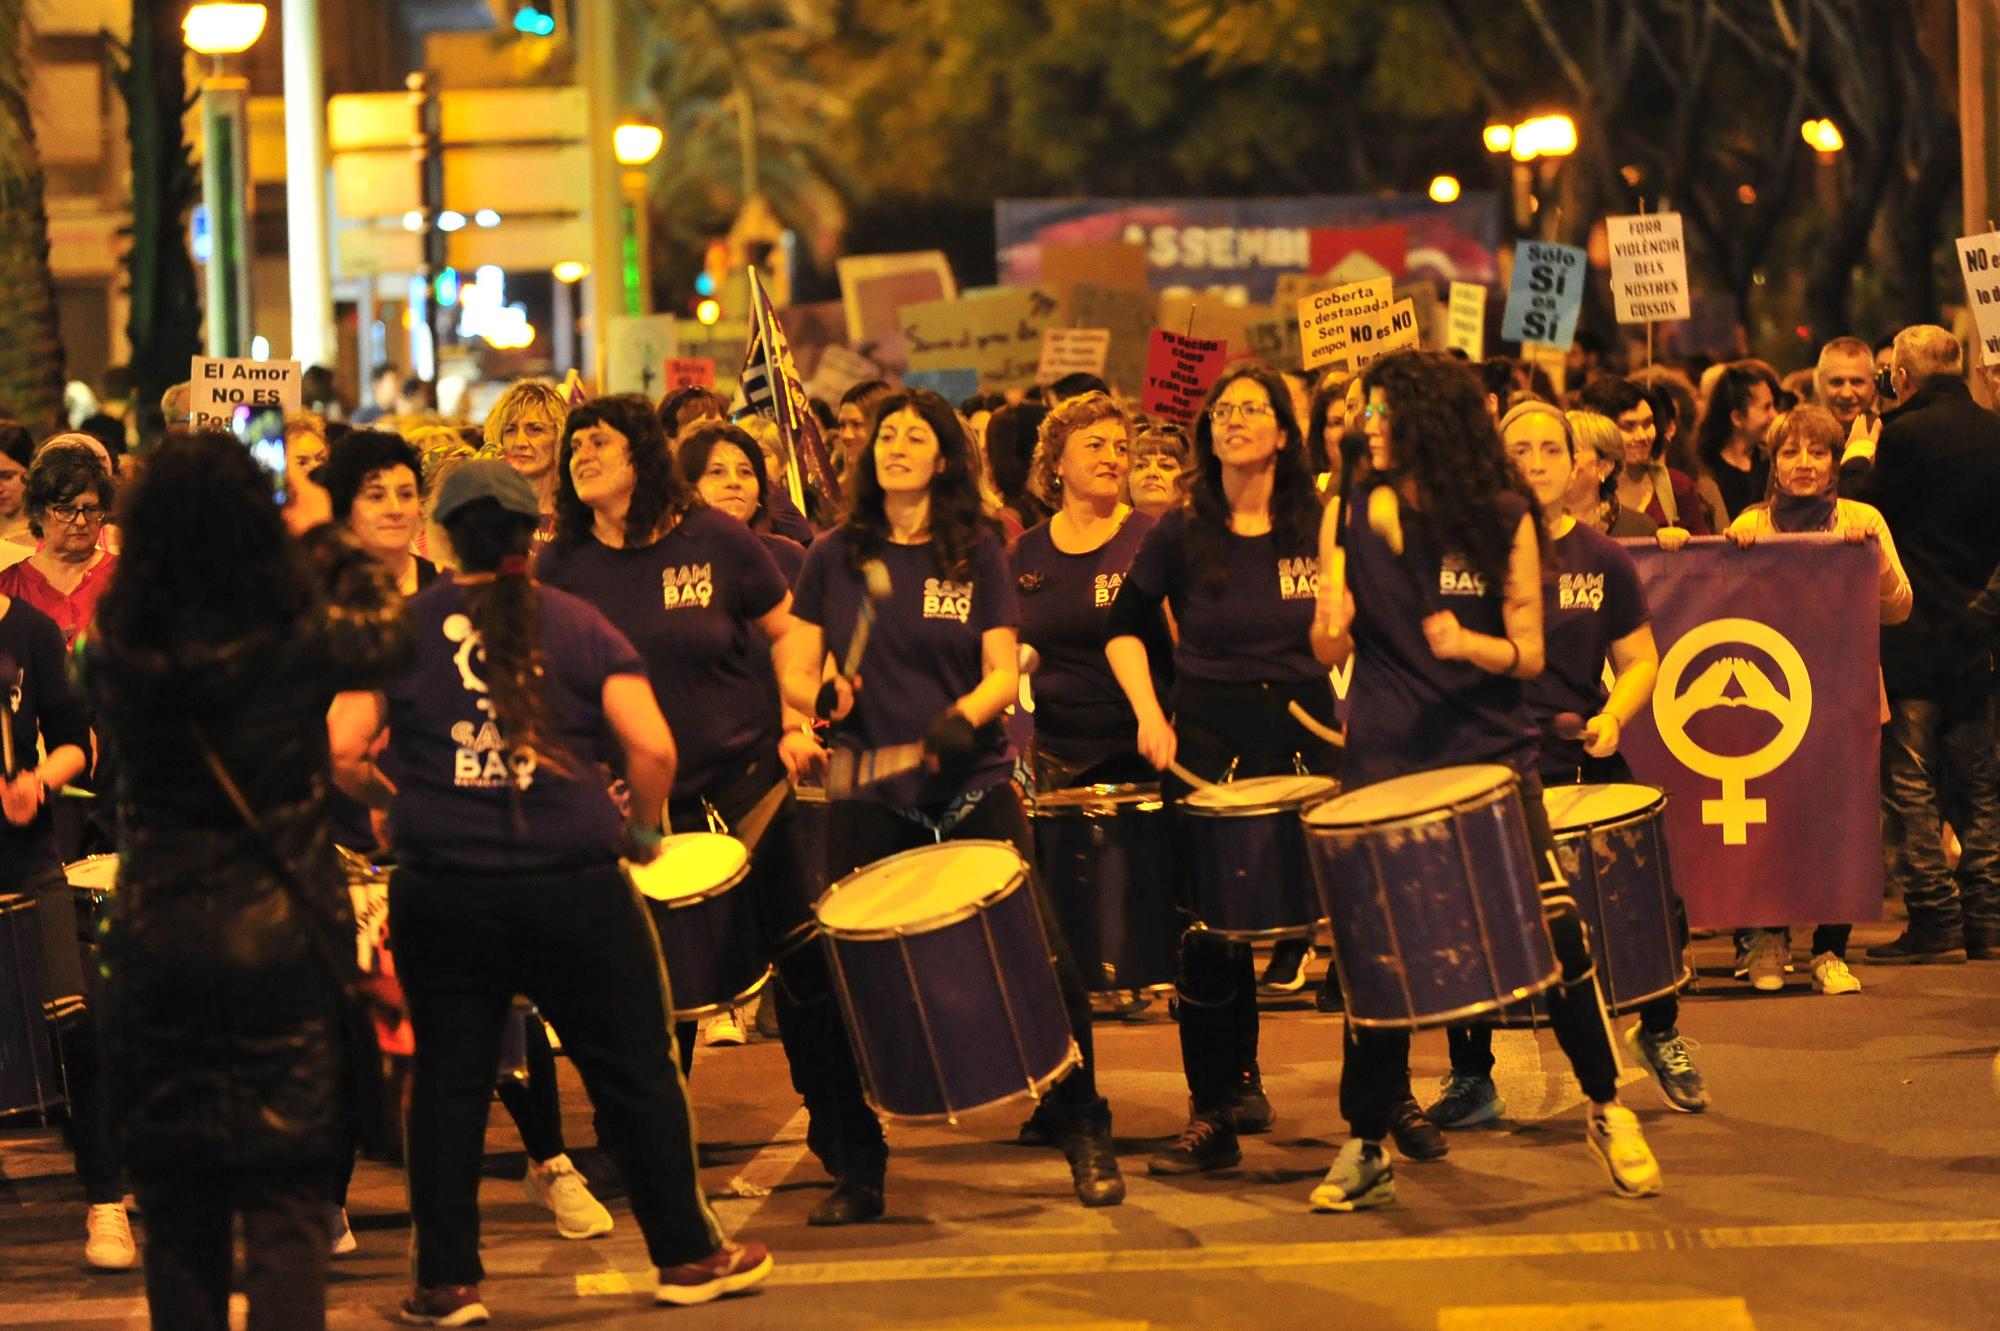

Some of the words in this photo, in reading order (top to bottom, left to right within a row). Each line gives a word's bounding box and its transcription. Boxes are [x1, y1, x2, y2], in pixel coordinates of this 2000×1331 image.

[1965, 248, 1988, 272] NO
[1624, 280, 1680, 297] NOSTRES
[1976, 288, 1991, 305] lo
[1314, 287, 1374, 310] Coberta
[1304, 319, 1312, 329] o
[1315, 299, 1389, 325] destapada
[1629, 301, 1678, 317] COSSOS
[1350, 324, 1373, 343] NO
[1376, 326, 1391, 340] es
[1392, 310, 1413, 333] NO
[204, 363, 224, 379] El
[231, 364, 290, 381] Amor
[212, 387, 245, 404] NO
[253, 389, 281, 405] ES
[662, 562, 712, 587] SAM
[1095, 573, 1127, 589] SA
[1559, 572, 1604, 590] SAM
[924, 577, 974, 598] SAM
